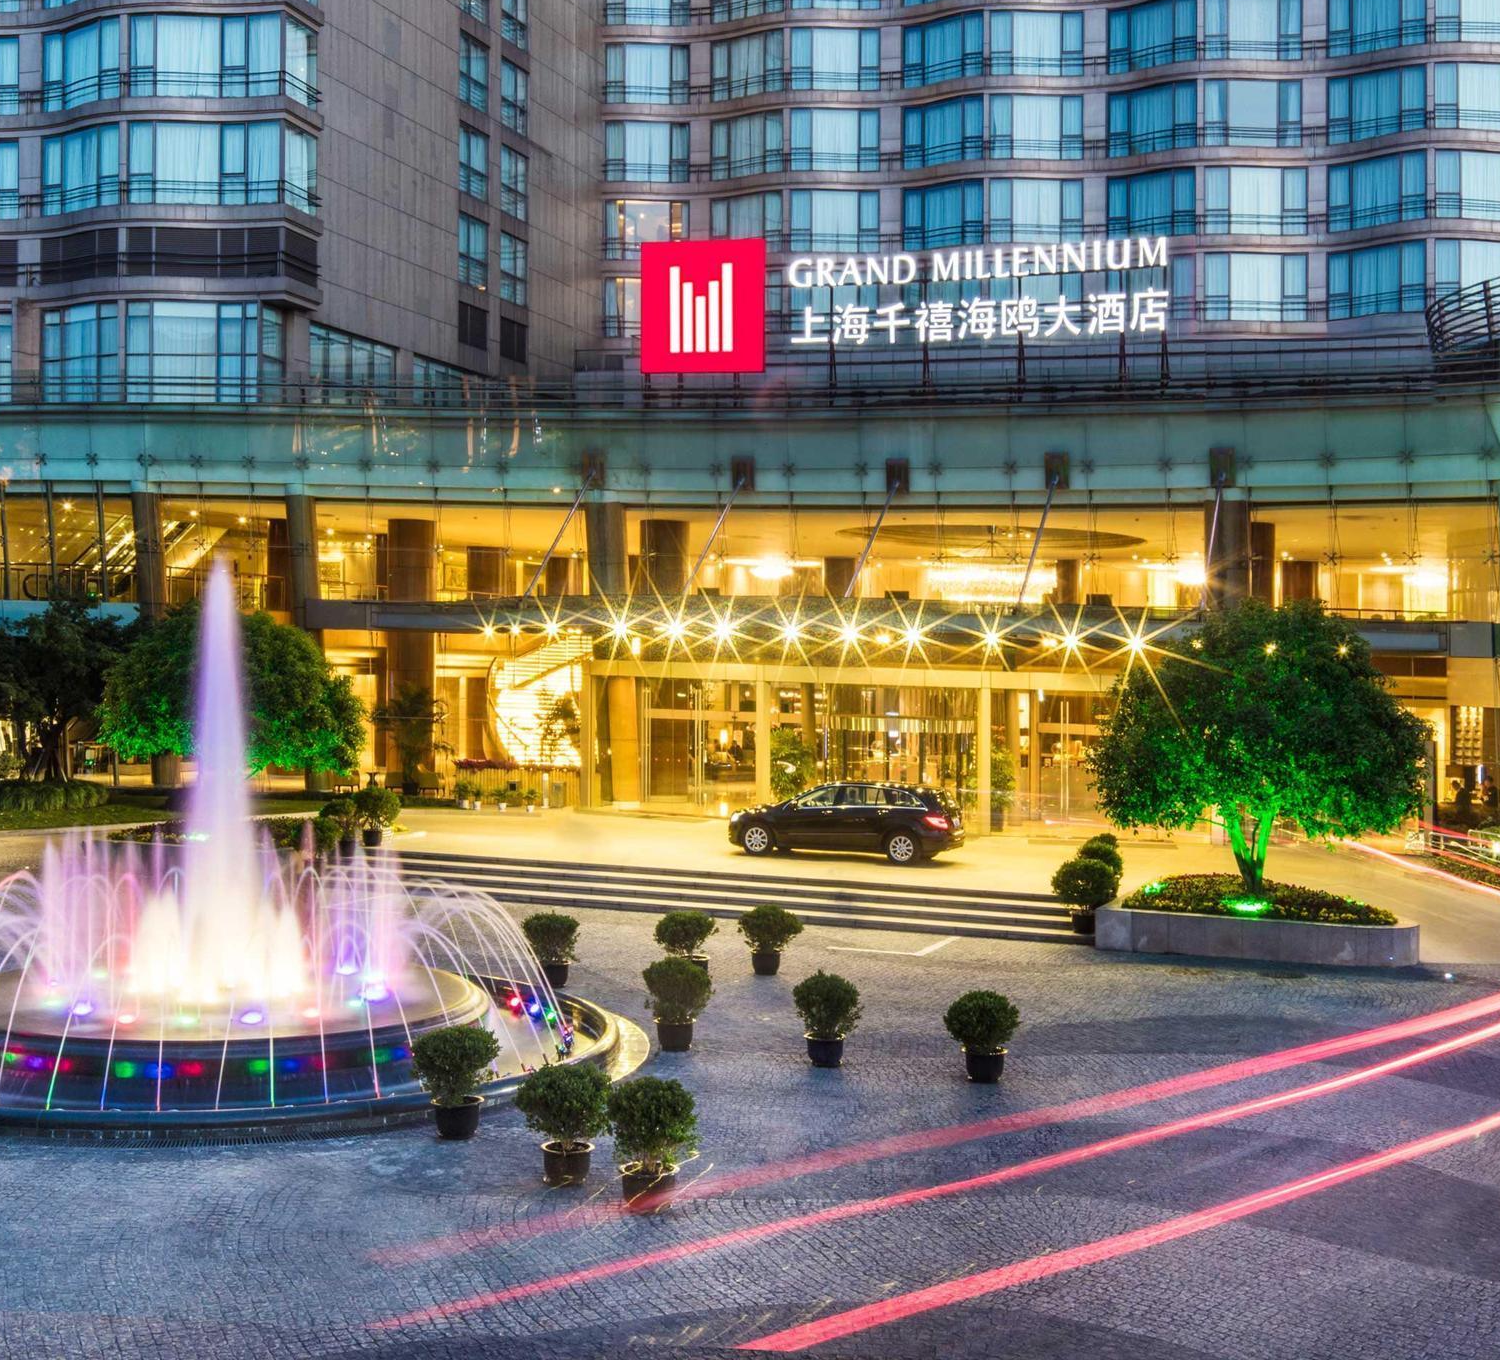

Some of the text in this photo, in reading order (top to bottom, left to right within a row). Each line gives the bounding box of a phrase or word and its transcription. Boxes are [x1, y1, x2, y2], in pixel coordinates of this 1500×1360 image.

[789, 237, 1167, 287] GRAND MILLENNIUM
[791, 288, 1169, 344] 上海千禧海鸥大酒店
